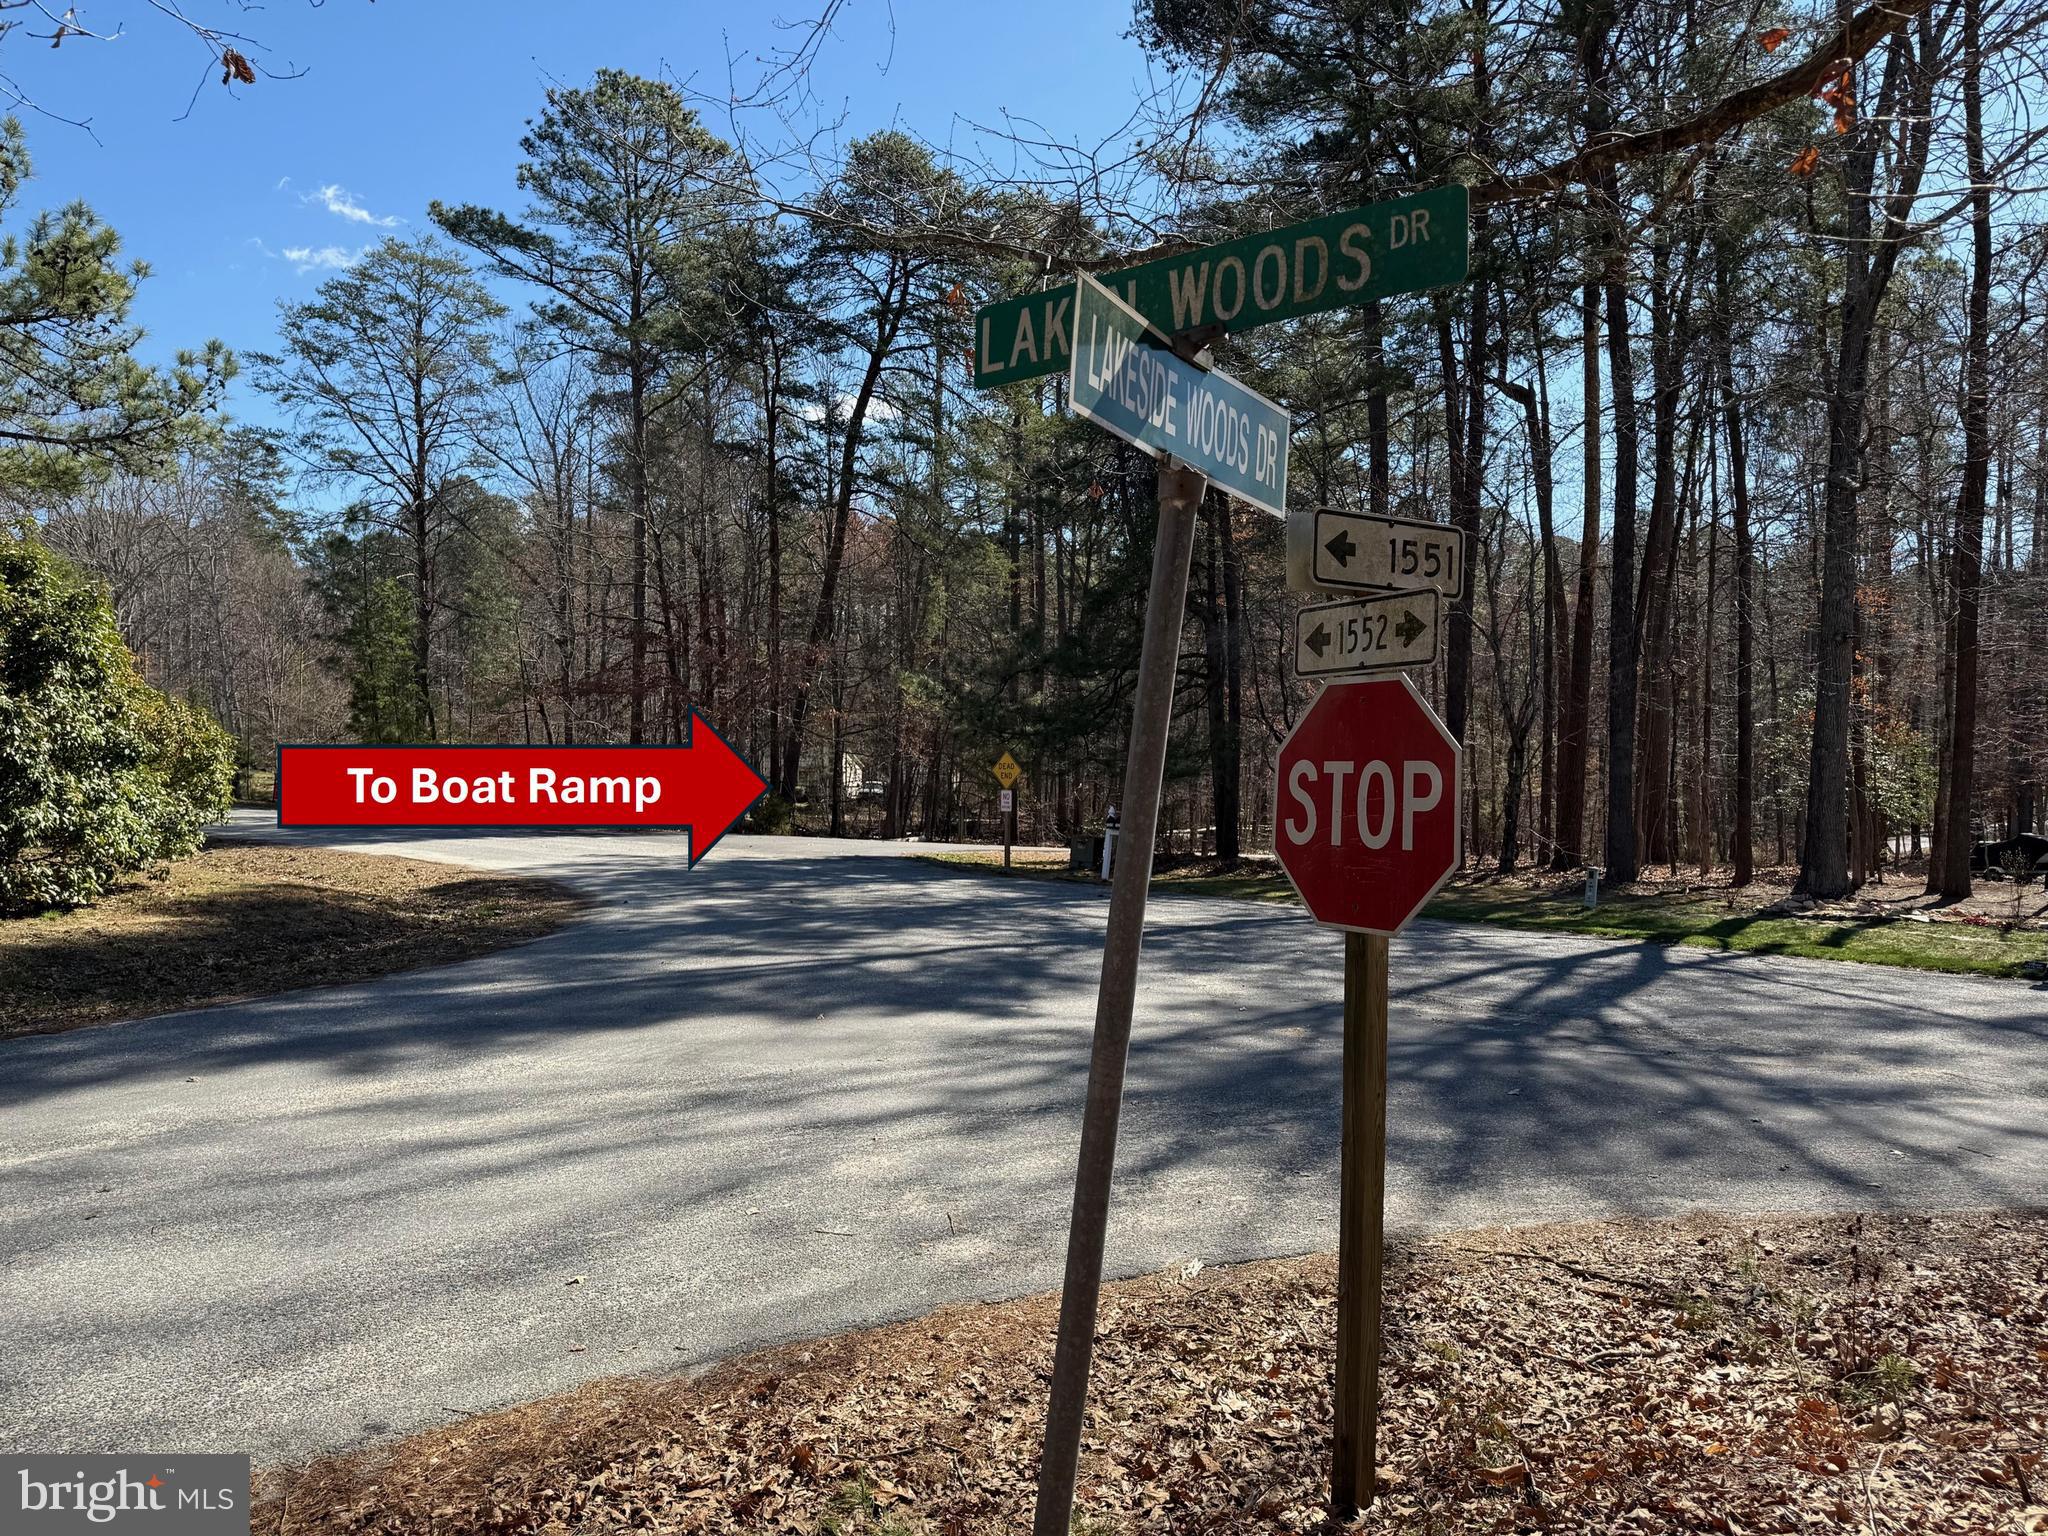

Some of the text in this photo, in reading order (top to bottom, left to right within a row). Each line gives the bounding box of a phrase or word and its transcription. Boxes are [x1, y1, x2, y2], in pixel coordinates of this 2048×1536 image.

[982, 209, 1430, 374] LAK WOODS DR
[1088, 314, 1279, 489] LAKESIDE WOODS DR
[1389, 537, 1455, 580] 1551
[1338, 614, 1388, 656] 1552
[1000, 772, 1013, 780] END
[1002, 792, 1011, 800] NO
[1284, 759, 1443, 851] STOP
